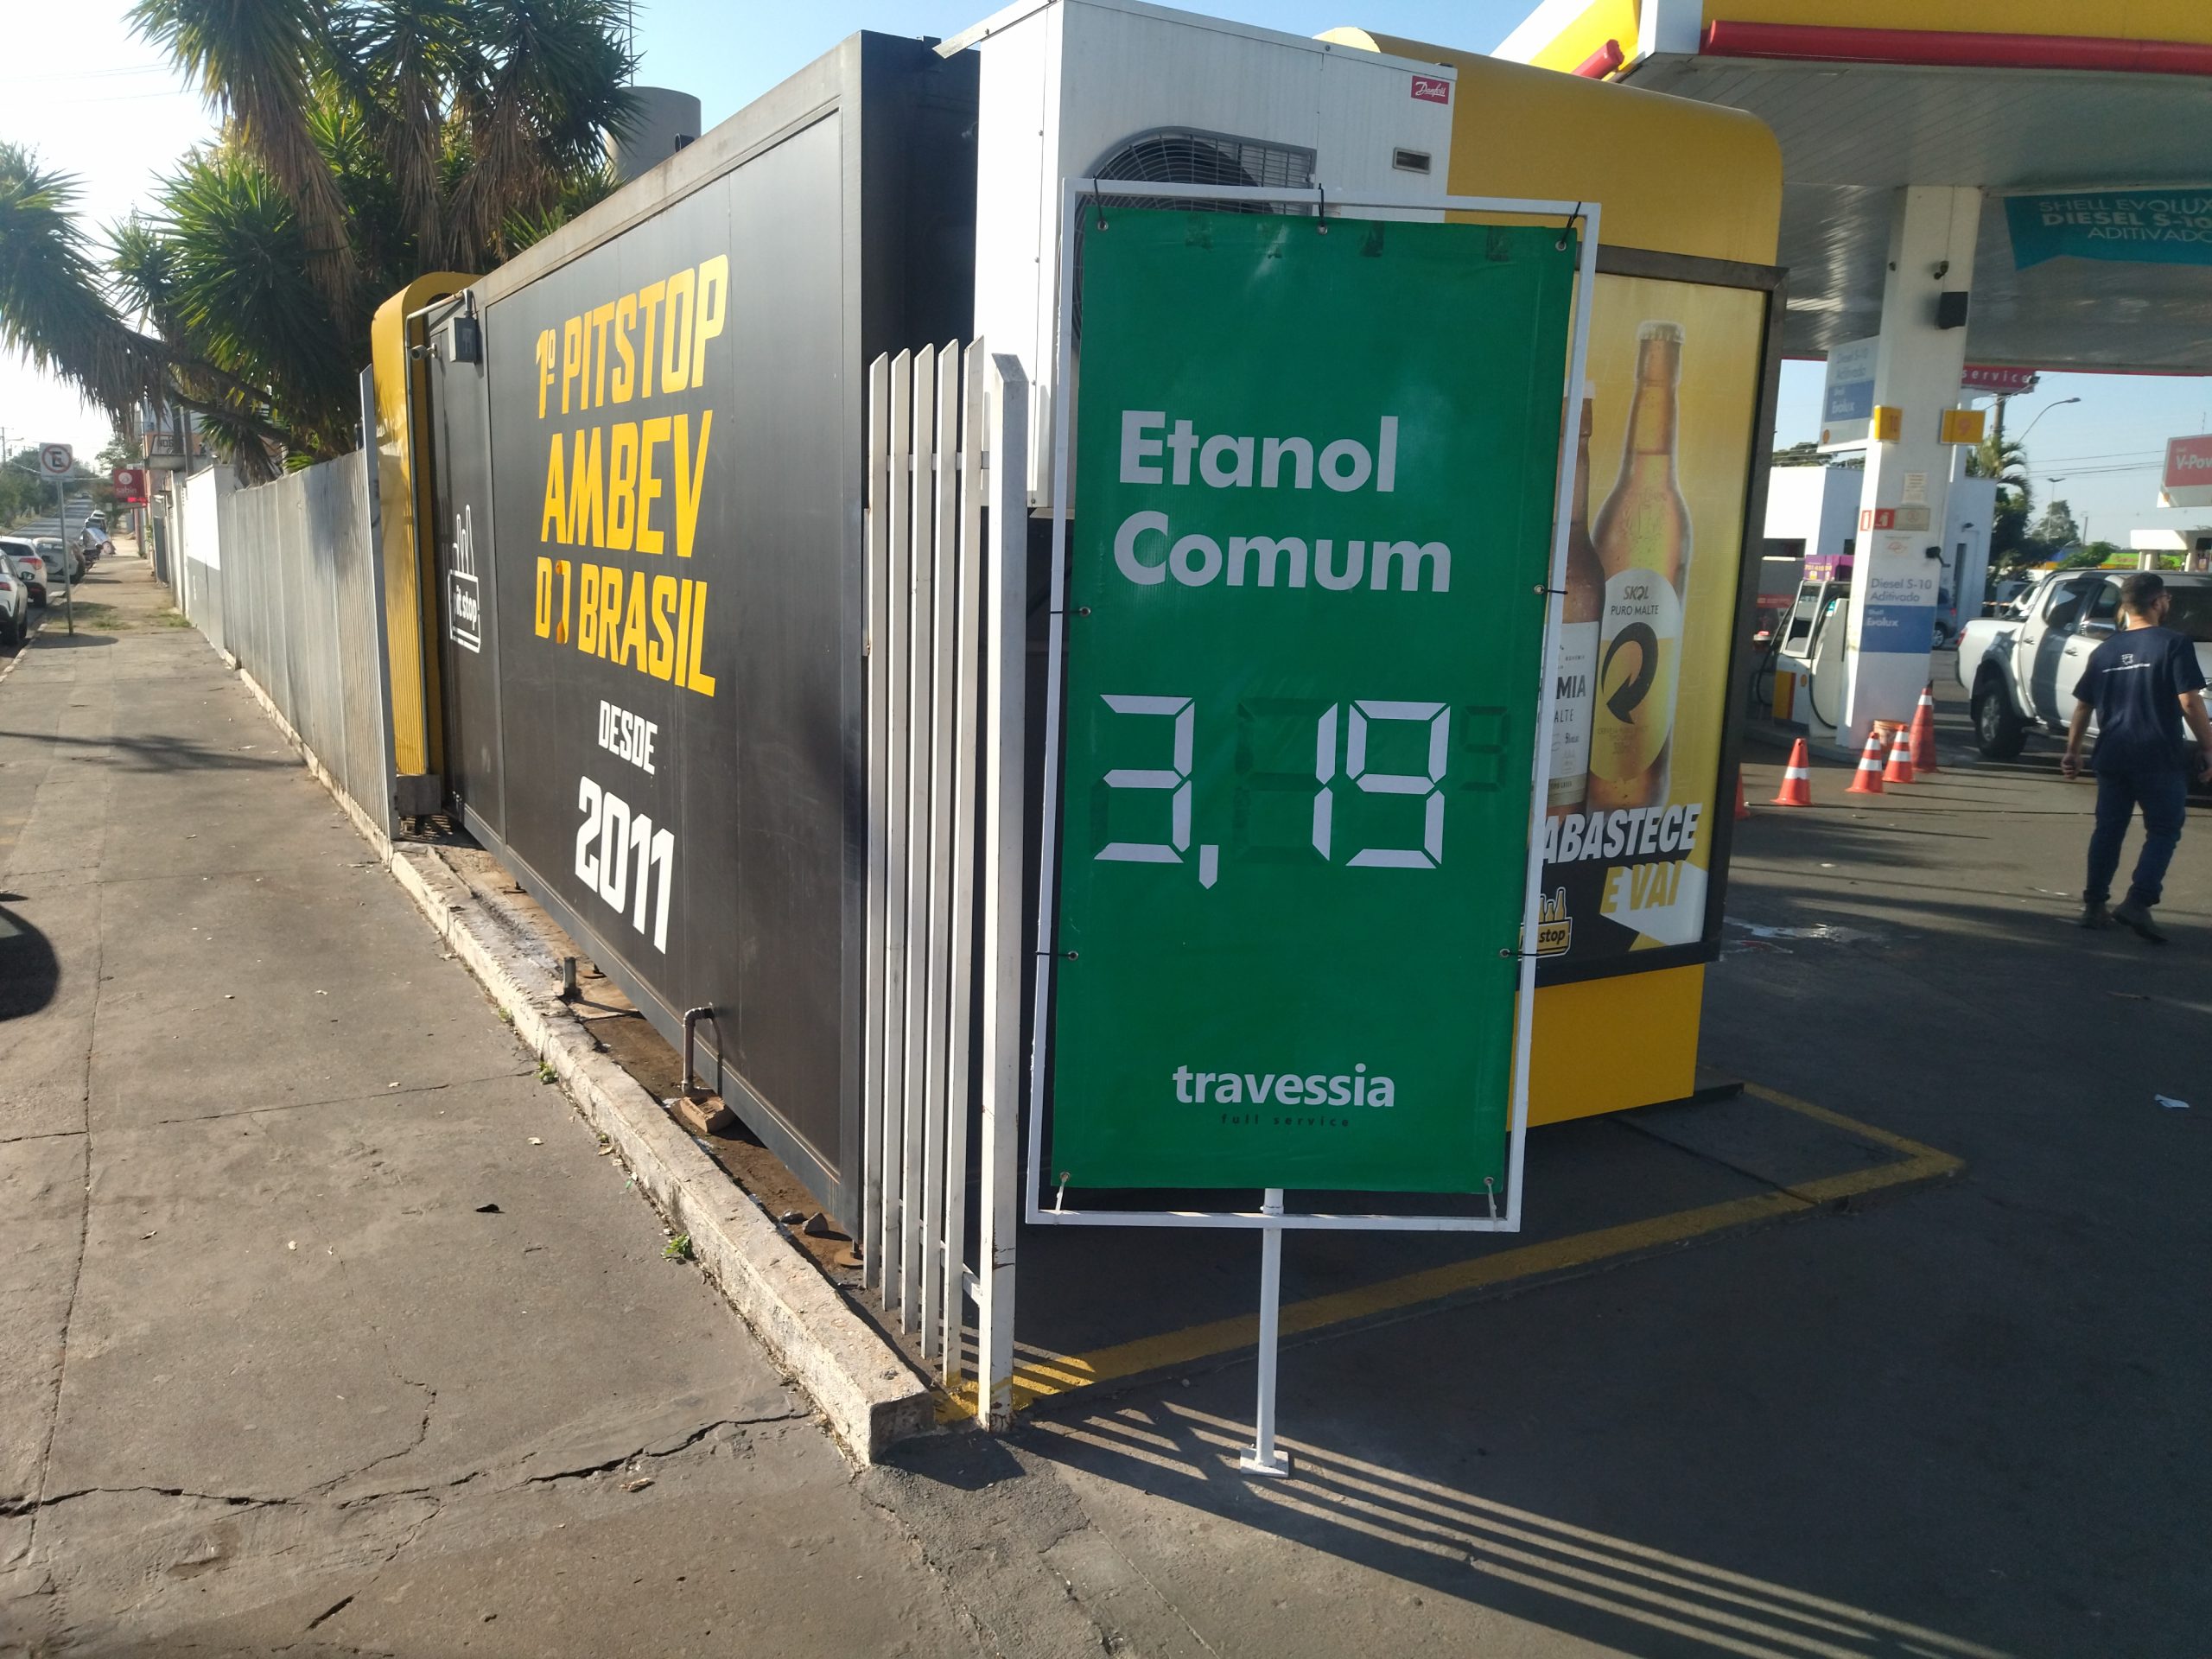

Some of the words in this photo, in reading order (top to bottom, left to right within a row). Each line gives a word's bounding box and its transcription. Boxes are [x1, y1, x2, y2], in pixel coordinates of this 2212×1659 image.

[2039, 199, 2110, 213] SHELL
[2042, 212, 2145, 226] DIESEL
[562, 254, 728, 415] PITSTOP
[1119, 410, 1399, 493] Etanol
[541, 410, 713, 558] AMBEV
[1114, 511, 1452, 593] Comum
[1624, 585, 1649, 601] SKOL
[1870, 591, 1920, 602] Aditivado
[1871, 577, 1904, 589] Diesel
[1907, 579, 1932, 590] S-10
[462, 590, 477, 632] stop
[1611, 605, 1632, 616] PURO
[1634, 605, 1659, 615] MALTE
[1866, 617, 1899, 628] Evolux
[578, 563, 715, 697] BRASIL
[1555, 675, 1586, 700] MIA
[1554, 709, 1574, 724] ALTE
[599, 700, 658, 775] DESDE
[1542, 803, 1702, 864] ABASTECE
[575, 776, 675, 954] 2011
[1600, 866, 1624, 913] E
[1630, 860, 1683, 912] VAI
[1538, 928, 1566, 944] stop
[1173, 1063, 1395, 1108] travessia
[1221, 1114, 1259, 1125] full
[1274, 1115, 1349, 1128] service
